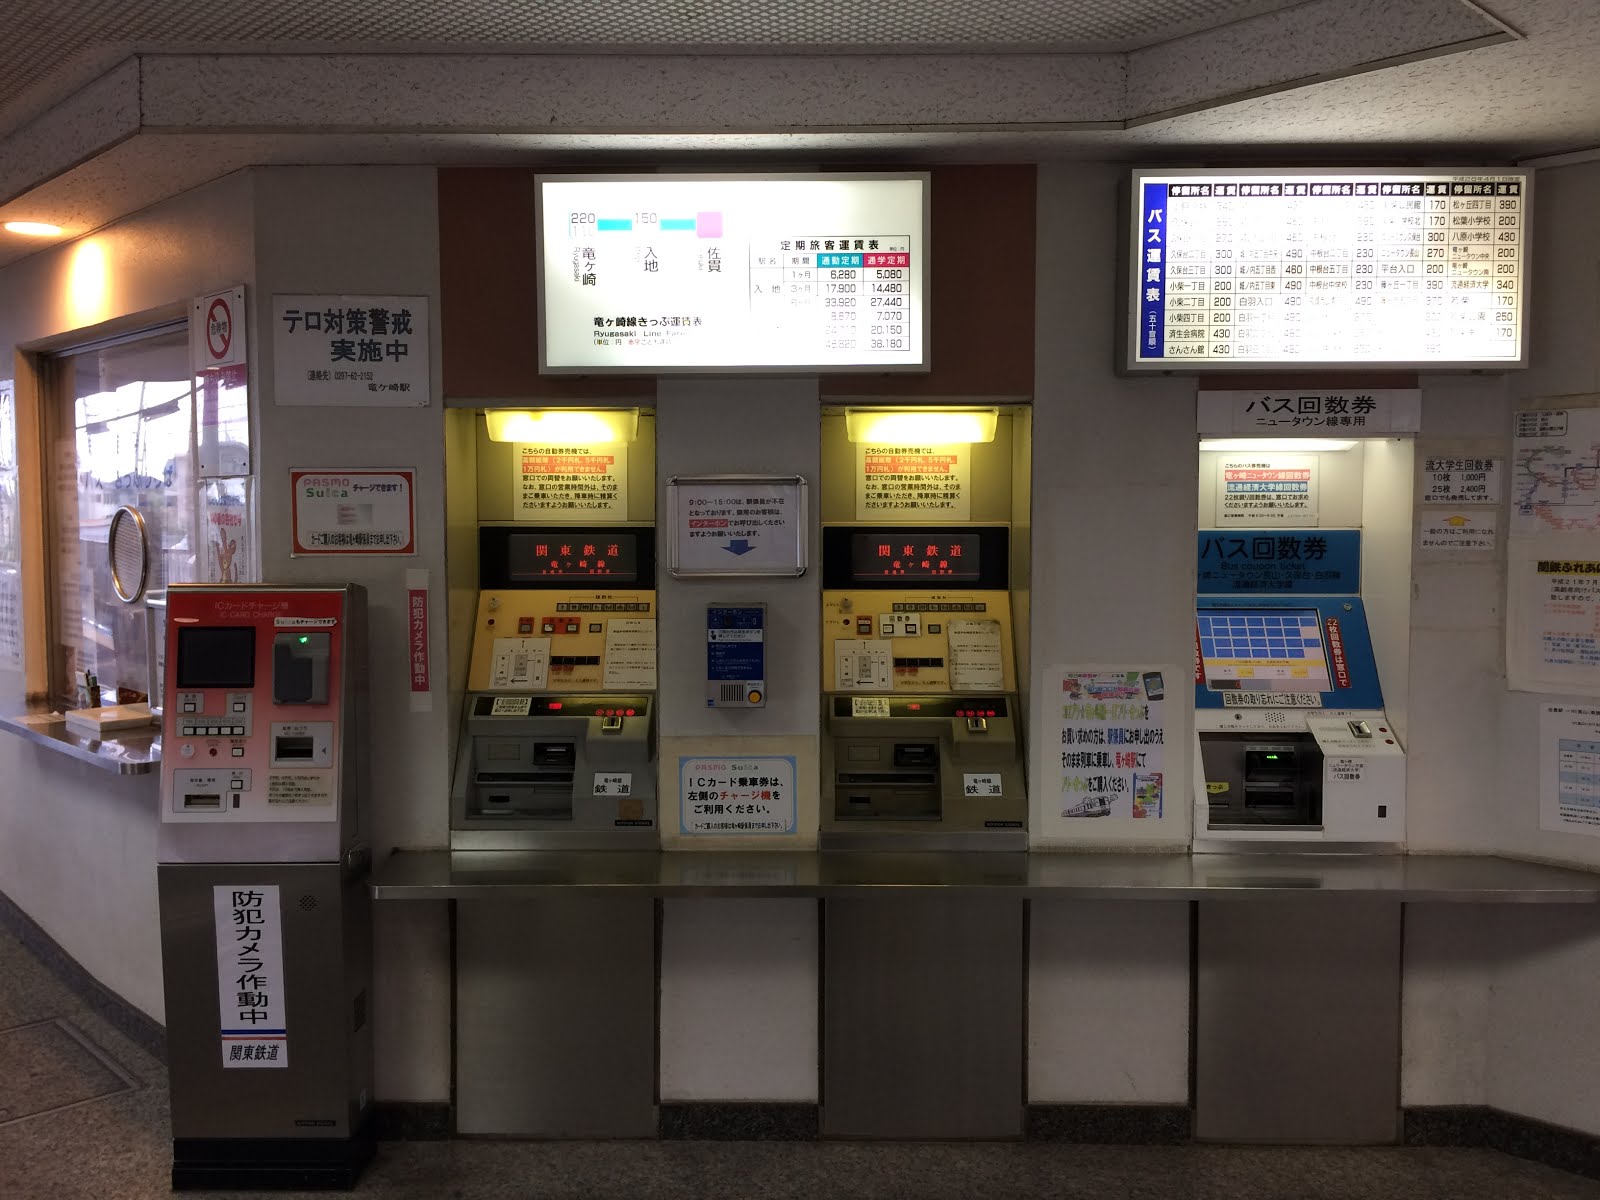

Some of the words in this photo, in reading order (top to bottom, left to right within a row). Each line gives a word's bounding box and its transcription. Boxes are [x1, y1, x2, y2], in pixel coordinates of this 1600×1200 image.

[1171, 185, 1210, 196] 停留所名
[1215, 186, 1237, 196] 運賃
[1241, 185, 1280, 196] 停留所名
[1285, 185, 1306, 195] 運賃
[1312, 185, 1350, 195] 停留所名
[1356, 185, 1377, 195] 運賃
[1382, 185, 1420, 195] 停留所名
[1427, 185, 1447, 195] 運賃
[1454, 184, 1491, 194] 停留所名
[1498, 184, 1519, 194] 運賃
[1430, 200, 1445, 209] 170
[1499, 200, 1516, 209] 390
[571, 213, 595, 224] 220
[635, 213, 657, 224] 150
[1429, 216, 1445, 225] 170
[1452, 216, 1490, 225] 松葉小学校
[1498, 217, 1515, 226] 200
[1428, 232, 1444, 241] 300
[1452, 232, 1490, 241] 八原小学校
[1498, 232, 1515, 241] 430
[781, 240, 879, 250] 定期旅客運賃表
[1147, 209, 1163, 302] バス運賃表
[1215, 249, 1232, 258] 300
[1285, 249, 1302, 258] 490
[1356, 249, 1373, 258] 230
[1427, 249, 1444, 257] 270
[1497, 248, 1514, 257] 200
[644, 247, 658, 272] 入地
[708, 247, 721, 272] 佐貫
[867, 255, 906, 264] 通学定期
[1170, 265, 1206, 275] 久保台三丁目
[1214, 265, 1231, 275] 300
[1309, 265, 1348, 274] 中根台五丁目
[1355, 265, 1372, 274] 230
[1381, 265, 1414, 273] 平台入口
[1426, 265, 1443, 273] 200
[1497, 264, 1514, 273] 200
[830, 270, 856, 280] 6,280
[877, 269, 902, 279] 5,080
[754, 285, 780, 293] 入地
[827, 284, 856, 294] 17,900
[872, 283, 902, 293] 14,480
[1169, 281, 1205, 291] 小柴一丁目
[1214, 281, 1231, 290] 200
[1285, 281, 1301, 290] 490
[1355, 281, 1372, 290] 230
[1426, 280, 1443, 289] 390
[1497, 280, 1513, 289] 340
[871, 298, 902, 307] 27,440
[1169, 297, 1204, 307] 小柴二丁目
[1213, 297, 1231, 307] 200
[1239, 297, 1273, 307] 白羽入口
[1497, 296, 1513, 305] 170
[878, 312, 902, 321] 7,070
[1169, 313, 1204, 323] 小柴四丁目
[1213, 313, 1230, 323] 200
[1496, 312, 1512, 321] 250
[283, 309, 412, 336] テロ対策警戒
[210, 320, 228, 337] 危険物
[871, 326, 902, 335] 20,150
[594, 330, 637, 340] Ryugasaki
[644, 330, 661, 339] Line
[1168, 330, 1205, 340] 済生会病院
[1213, 330, 1230, 339] 430
[331, 340, 408, 362] 実施中
[1168, 345, 1205, 356] さんさん館
[1212, 345, 1230, 355] 430
[335, 371, 374, 381] 0297-62-2152
[1247, 396, 1375, 416] バス回数券
[1257, 417, 1365, 429] ニュータウン線専用
[1425, 460, 1493, 471] 流大学生回数券
[303, 478, 350, 487] PASMO
[1433, 474, 1450, 482] 10枚
[1461, 473, 1486, 482] 1,000円
[1227, 483, 1308, 491] 流通経済大学線回数券
[1432, 485, 1450, 493] 25枚
[1461, 485, 1486, 493] 2,400円
[306, 488, 349, 498] Suica
[690, 520, 784, 529] インターホンでお呼び出しください
[690, 531, 760, 540] ますようお願いいたします。
[536, 545, 619, 556] 関東鉄道
[878, 545, 962, 556] 関東鉄道
[1201, 537, 1327, 561] バス回数券
[1221, 562, 1239, 570] Bus
[215, 602, 288, 611] ICカードチャージ機
[413, 597, 425, 686] 防犯カメラ作動中
[690, 778, 784, 788] ICカード乗車券は、
[595, 785, 629, 794] 鉄道
[966, 785, 1000, 794] 鉄道
[688, 791, 780, 801] 左側のチャージ機を
[694, 804, 770, 815] ご利用ください。
[232, 891, 268, 1024] 防犯カメラ作動中
[229, 1045, 279, 1061] 関東鉄道
